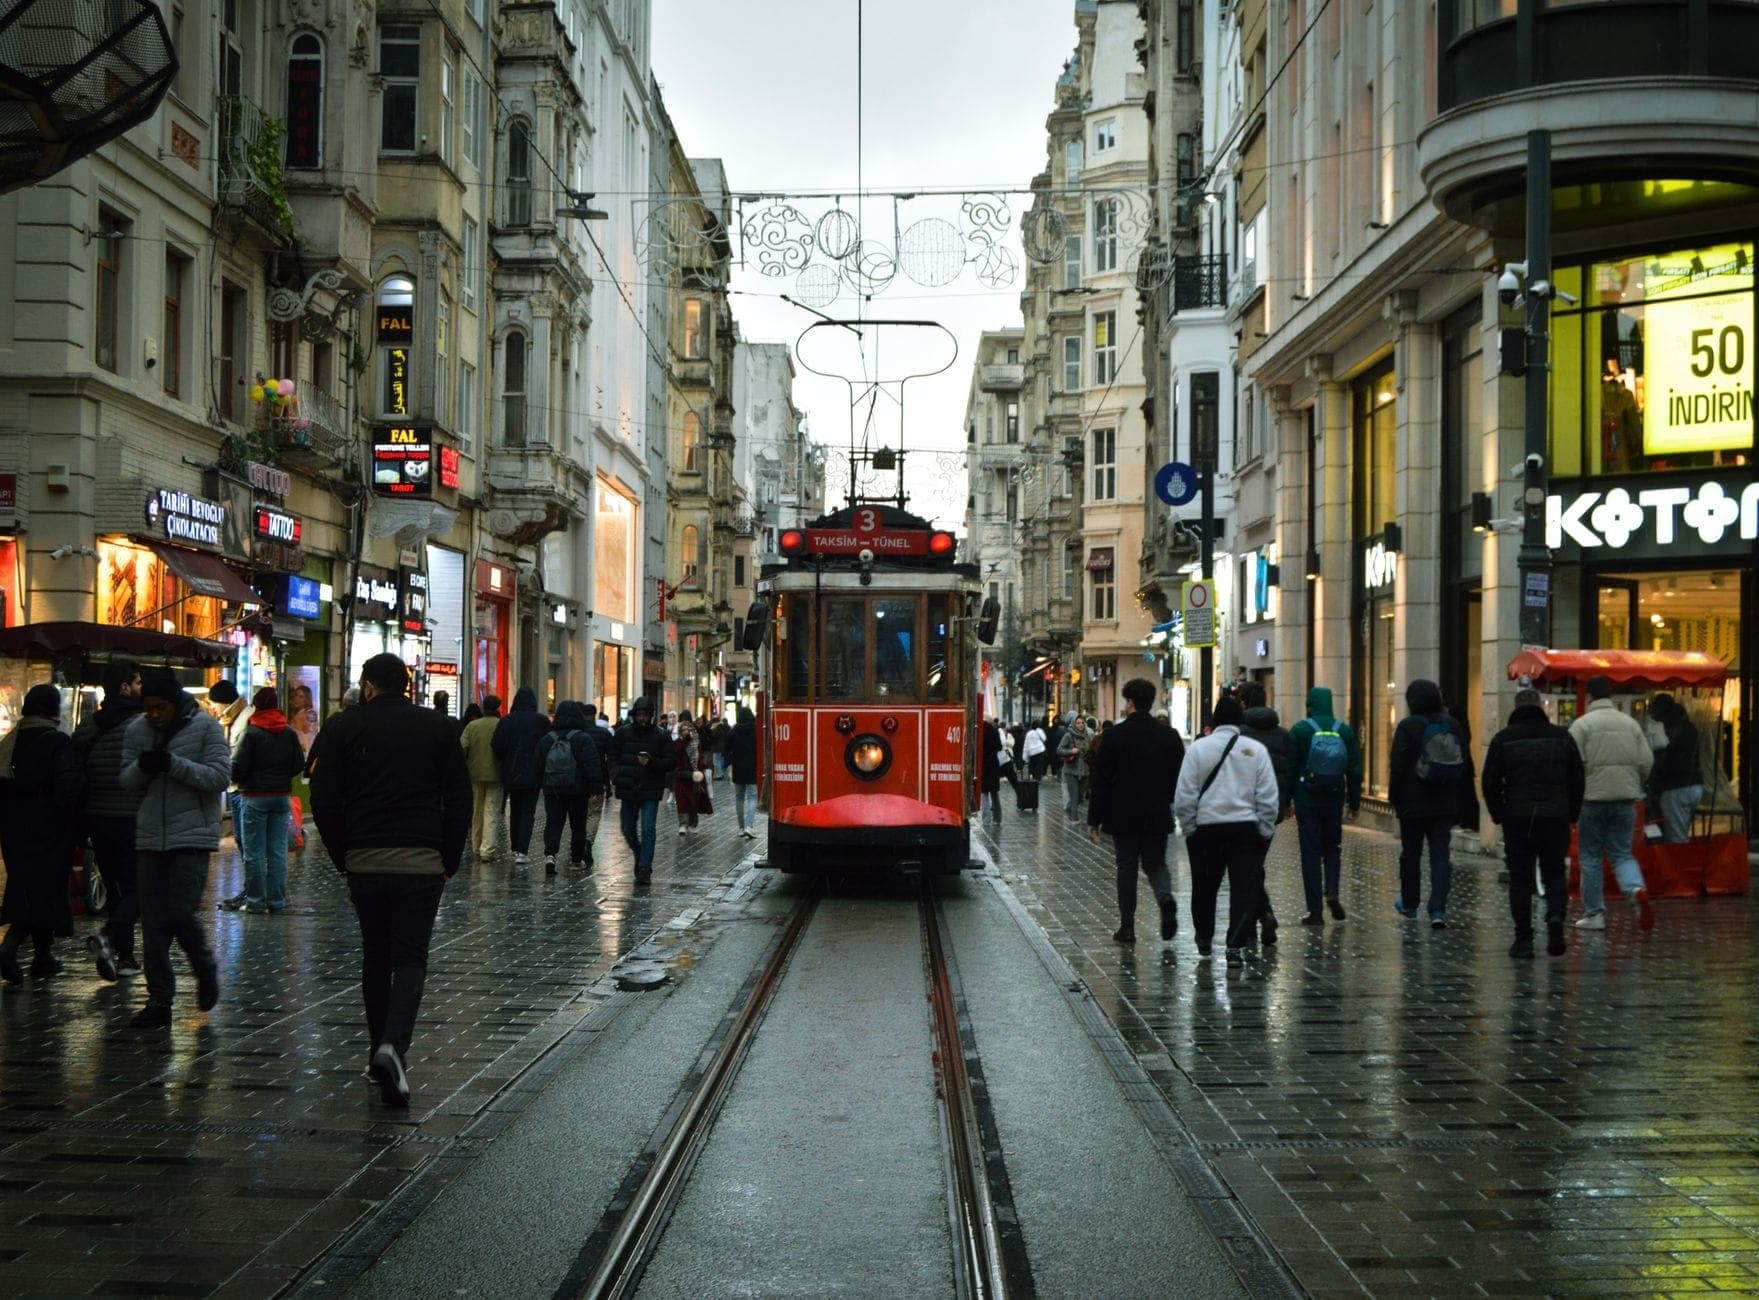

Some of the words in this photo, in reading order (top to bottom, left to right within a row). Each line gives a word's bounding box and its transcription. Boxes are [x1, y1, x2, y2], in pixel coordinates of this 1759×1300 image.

[381, 318, 411, 329] FAL
[1691, 325, 1744, 378] 50
[391, 429, 417, 443] FAL
[390, 484, 415, 492] TAROT
[160, 489, 189, 515] TARİHİ
[191, 498, 224, 524] BEYOĞLU
[167, 511, 218, 544] ÇİKOLATACISI
[268, 512, 294, 541] TATTOO
[860, 509, 875, 531] 3
[814, 535, 857, 546] TAKSİM
[872, 538, 910, 548] TÜNEL
[946, 726, 960, 743] 410
